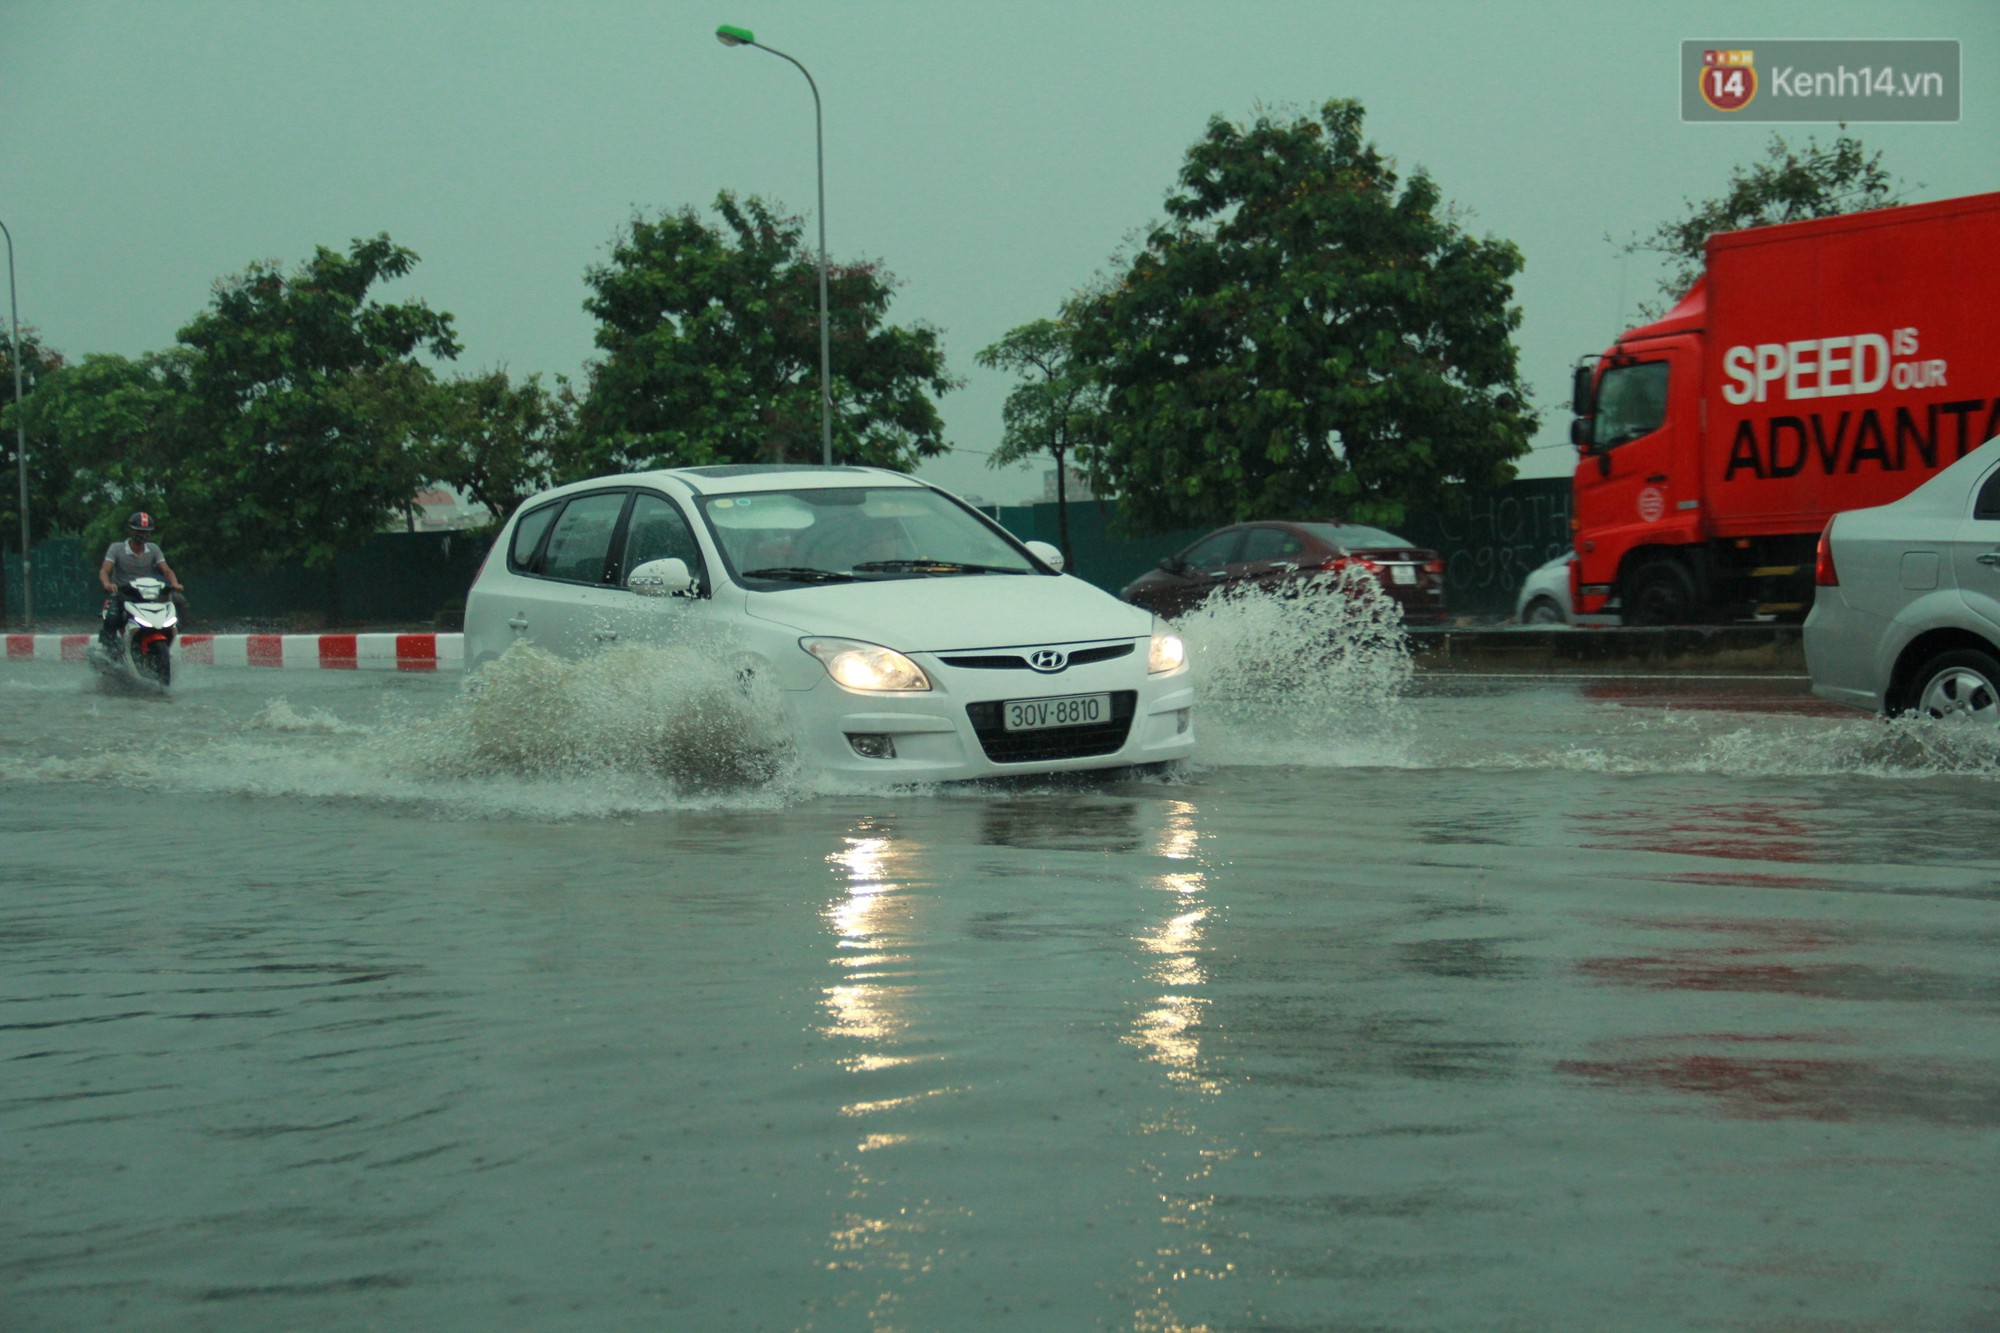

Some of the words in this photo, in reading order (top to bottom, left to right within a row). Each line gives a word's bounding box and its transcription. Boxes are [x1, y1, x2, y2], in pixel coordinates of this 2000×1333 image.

[1721, 333, 1890, 405] SPEED
[1892, 327, 1918, 355] IS
[1892, 359, 1947, 390] OUR
[1011, 698, 1099, 728] 30V-8810
